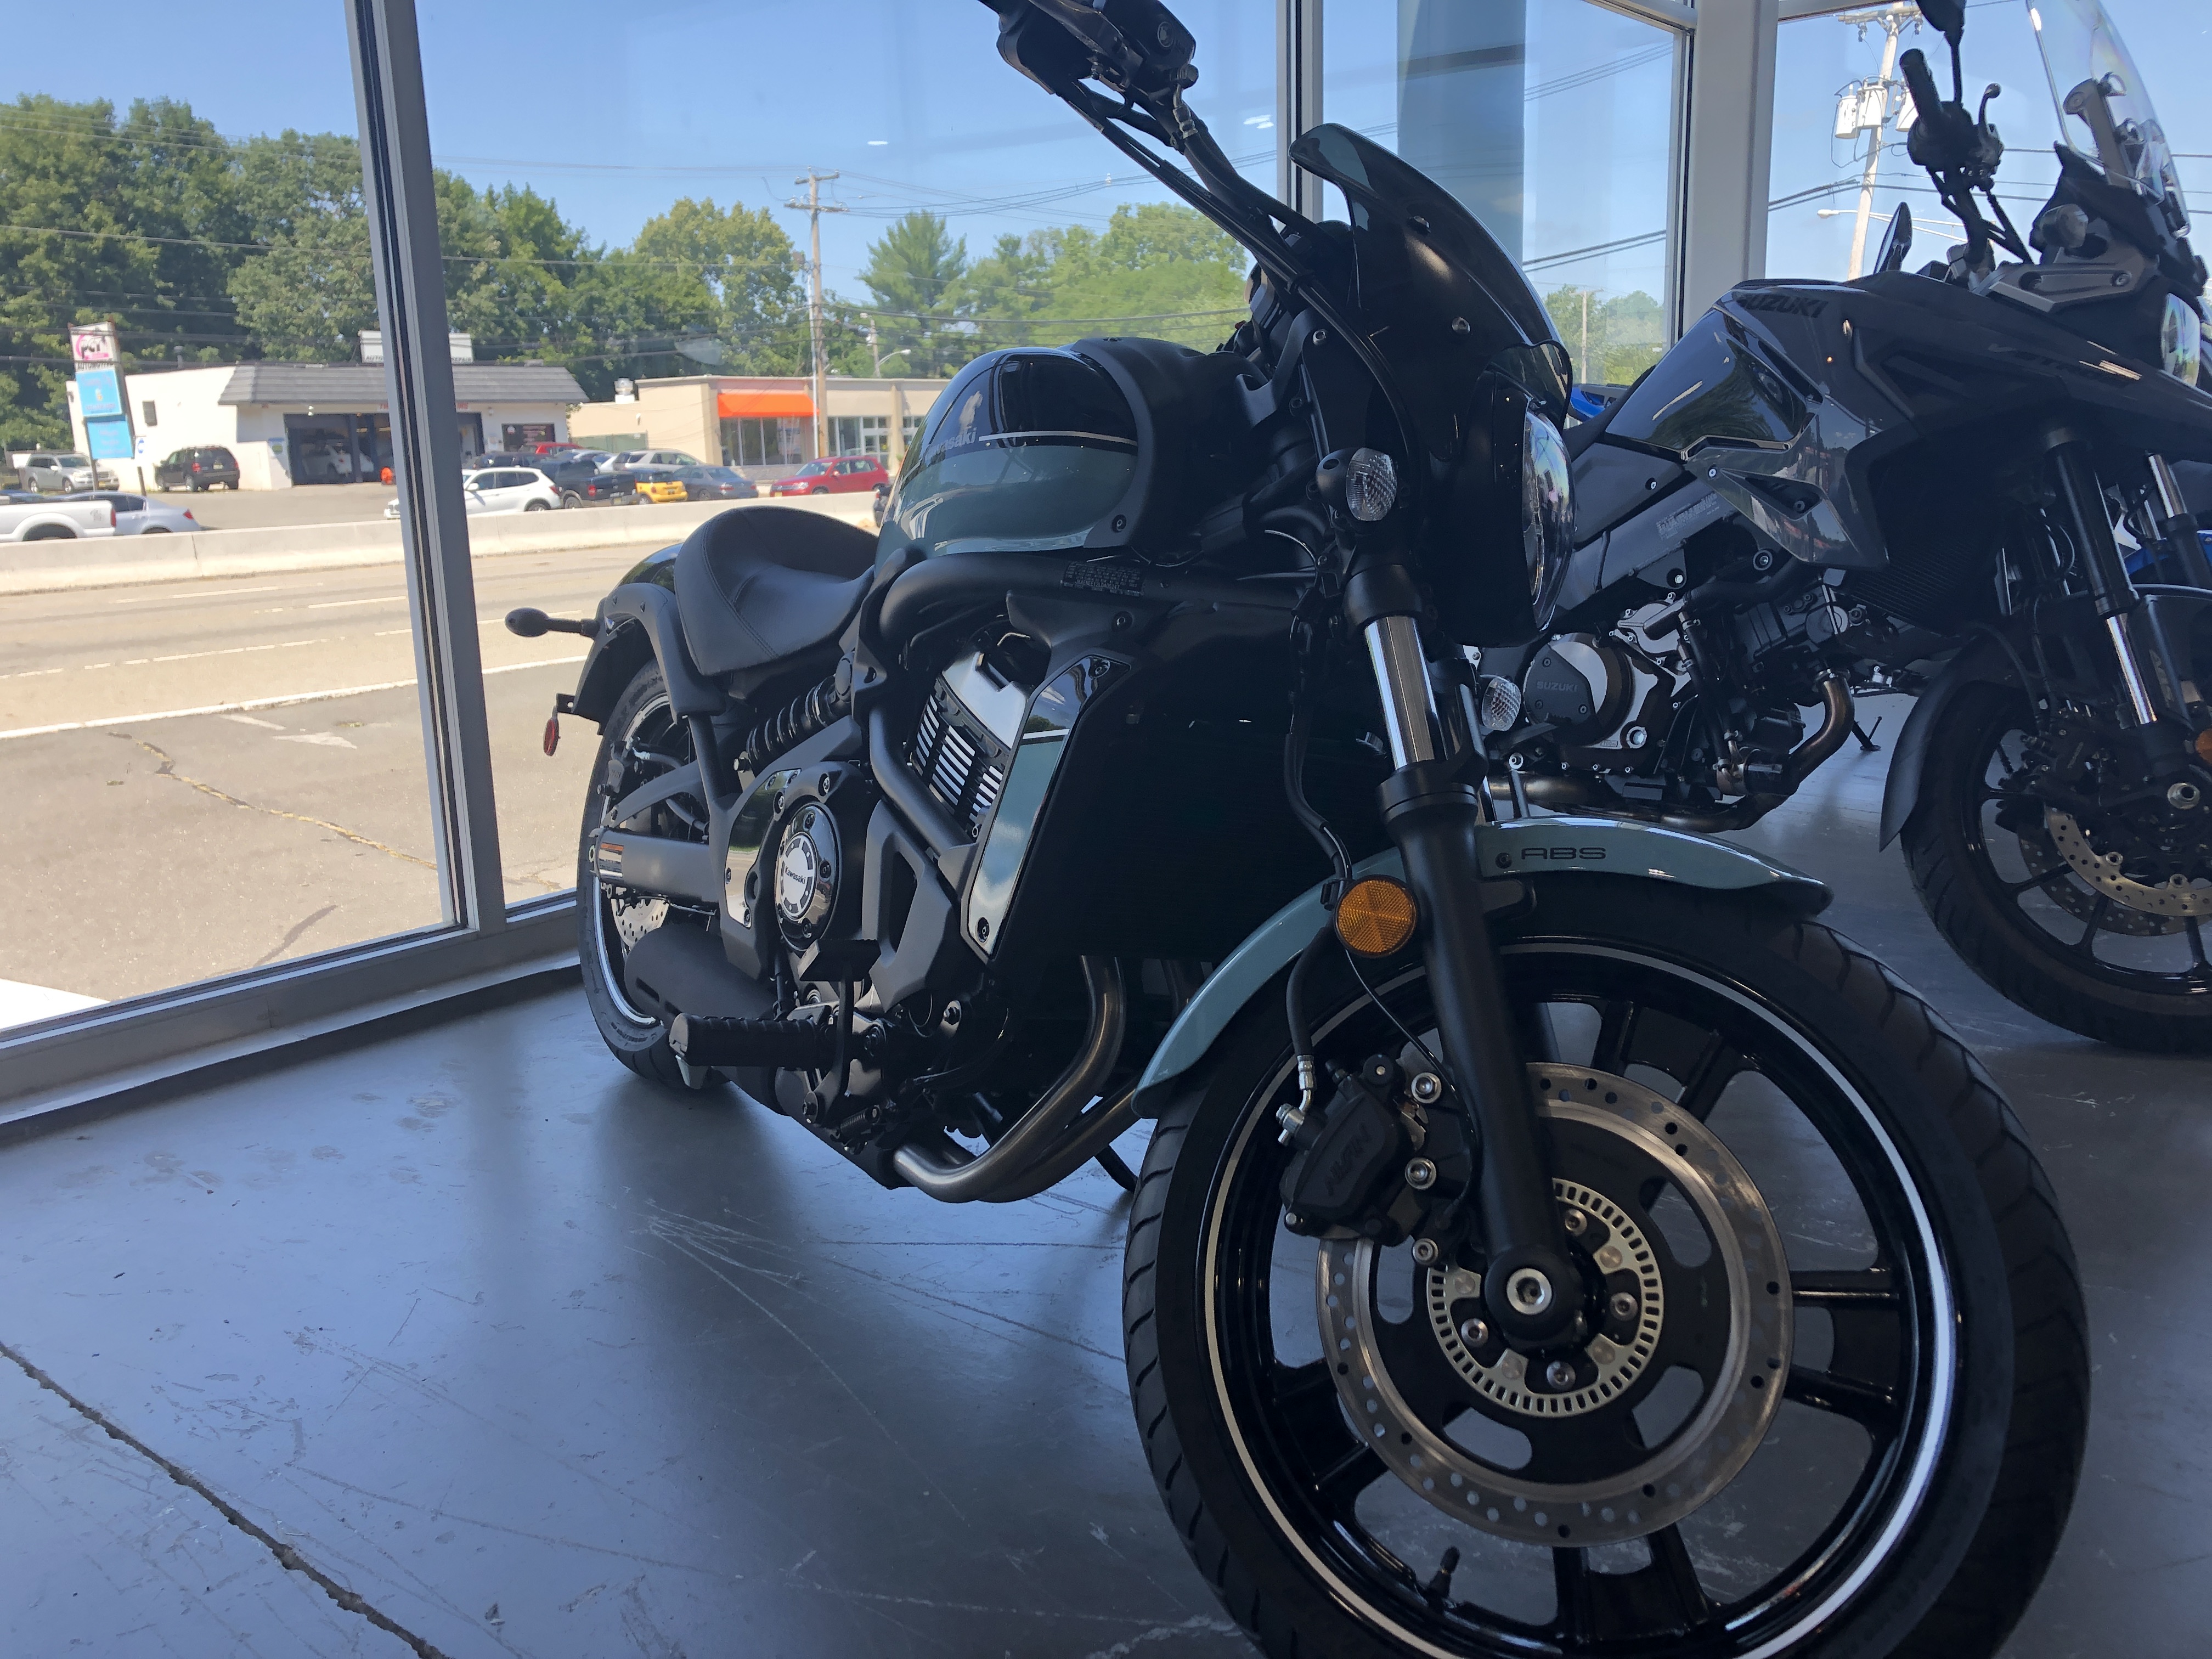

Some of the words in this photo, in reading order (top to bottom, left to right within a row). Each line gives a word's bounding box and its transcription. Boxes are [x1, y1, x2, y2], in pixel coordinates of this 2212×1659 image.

[1736, 292, 1829, 318] SUZUKI
[1536, 681, 1578, 692] SUZUKI
[1521, 847, 1606, 860] ABS
[785, 866, 806, 884] Kawasaki
